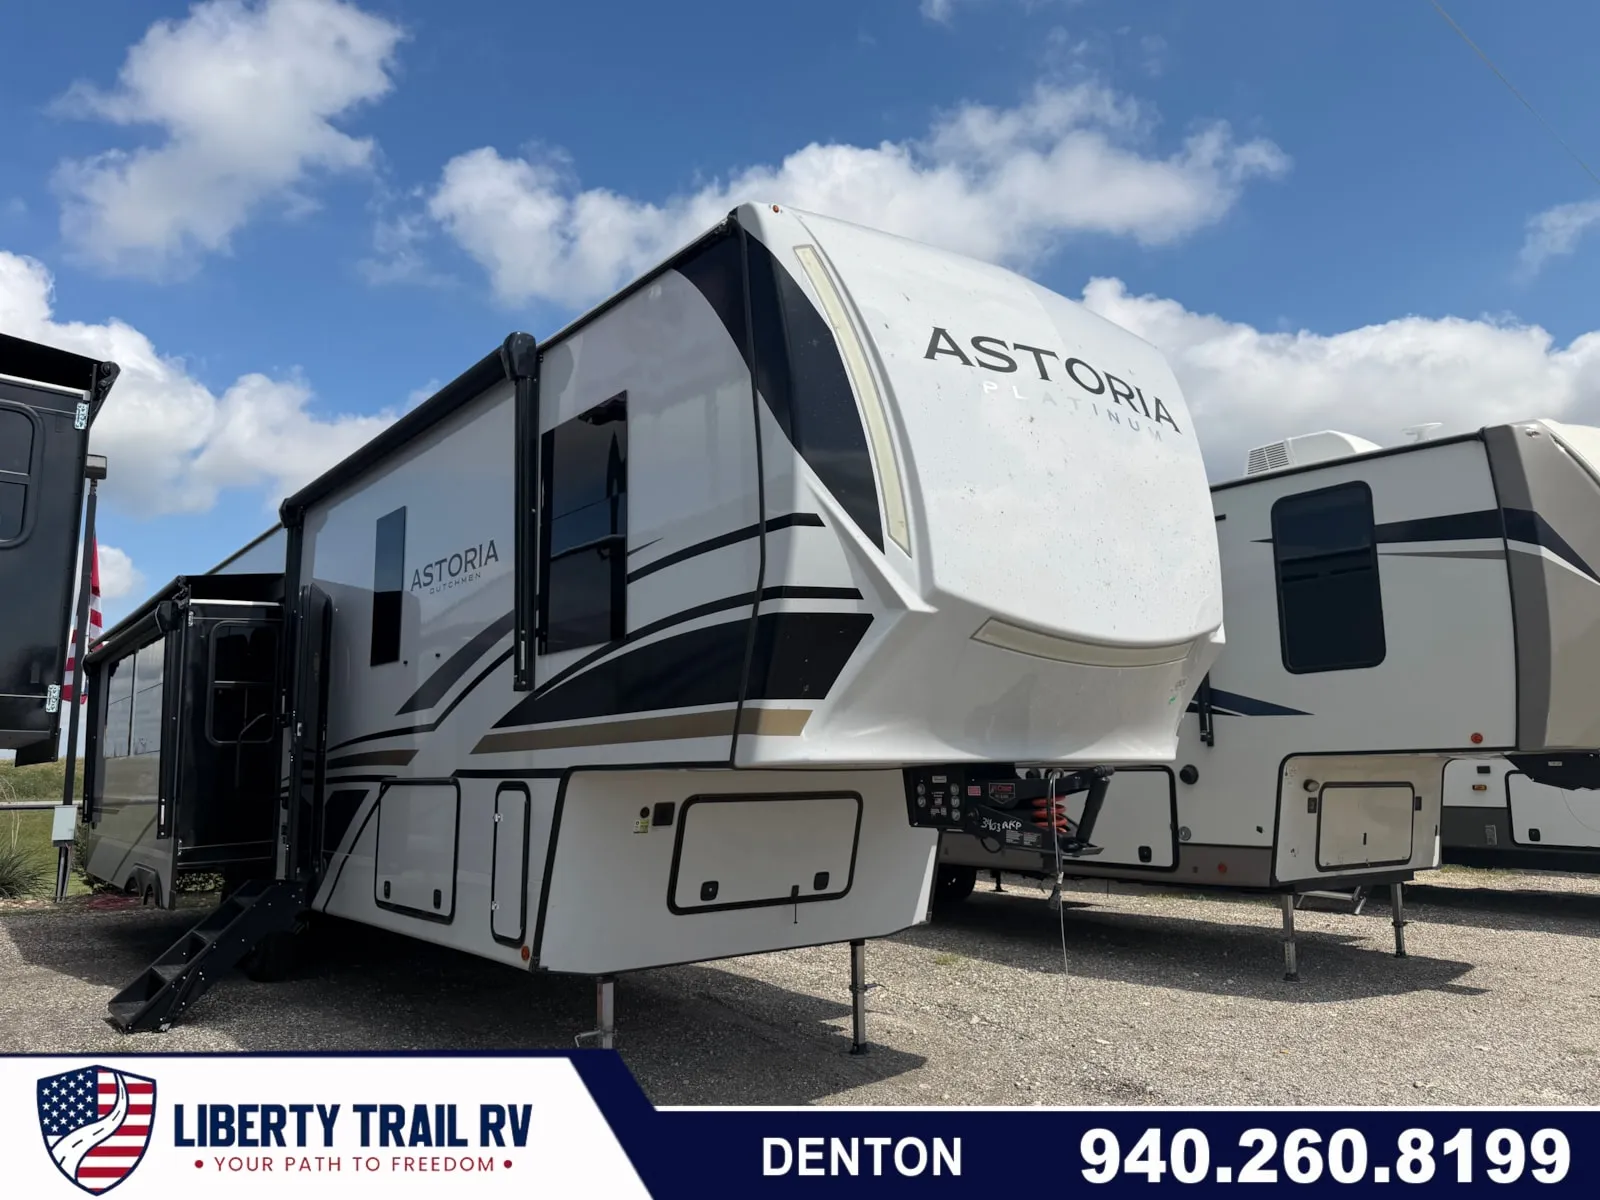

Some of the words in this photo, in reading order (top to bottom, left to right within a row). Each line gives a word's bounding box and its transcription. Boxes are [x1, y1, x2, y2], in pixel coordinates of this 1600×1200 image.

[923, 326, 1182, 434] ASTORIA
[982, 380, 1162, 442] PLATINUM
[410, 539, 499, 592] ASTORIA
[429, 572, 481, 595] DUTCHMEN
